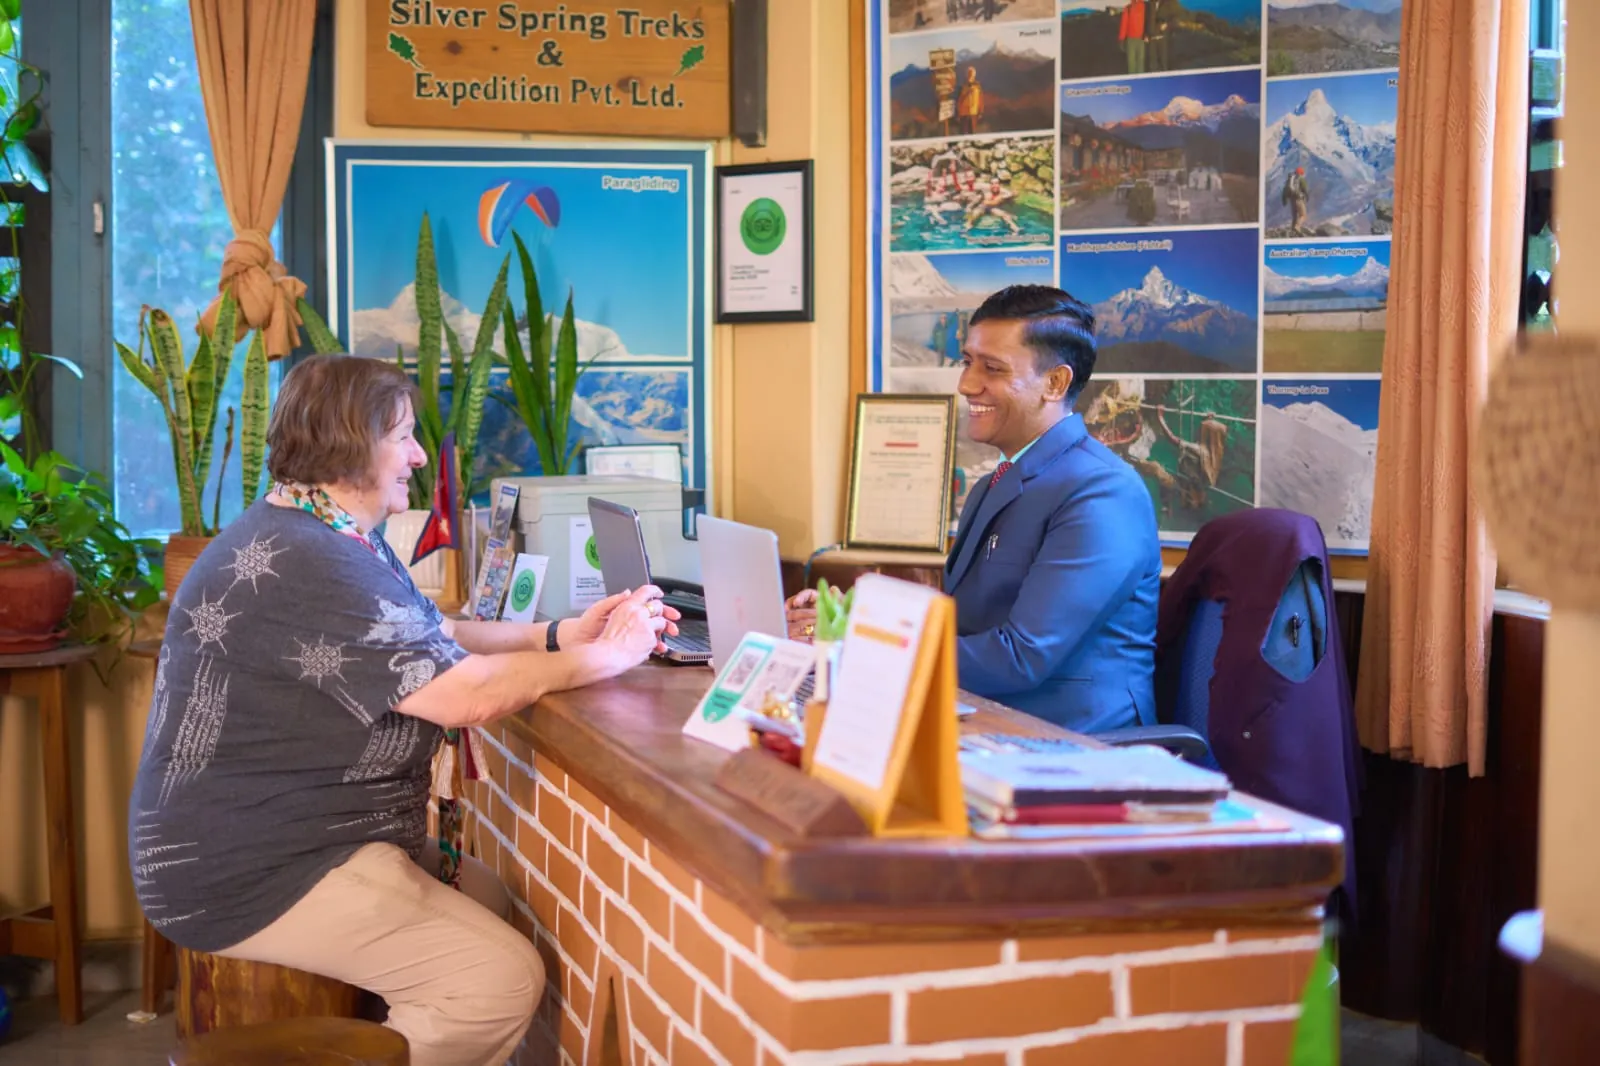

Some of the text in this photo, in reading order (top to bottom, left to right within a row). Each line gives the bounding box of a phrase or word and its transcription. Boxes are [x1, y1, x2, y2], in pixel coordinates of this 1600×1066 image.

[389, 0, 706, 40] Silver Spring Treks
[537, 40, 564, 67] &
[415, 73, 685, 108] Expedition Pvt. Ltd.
[602, 176, 680, 193] Paragliding
[1269, 249, 1308, 259] Australian
